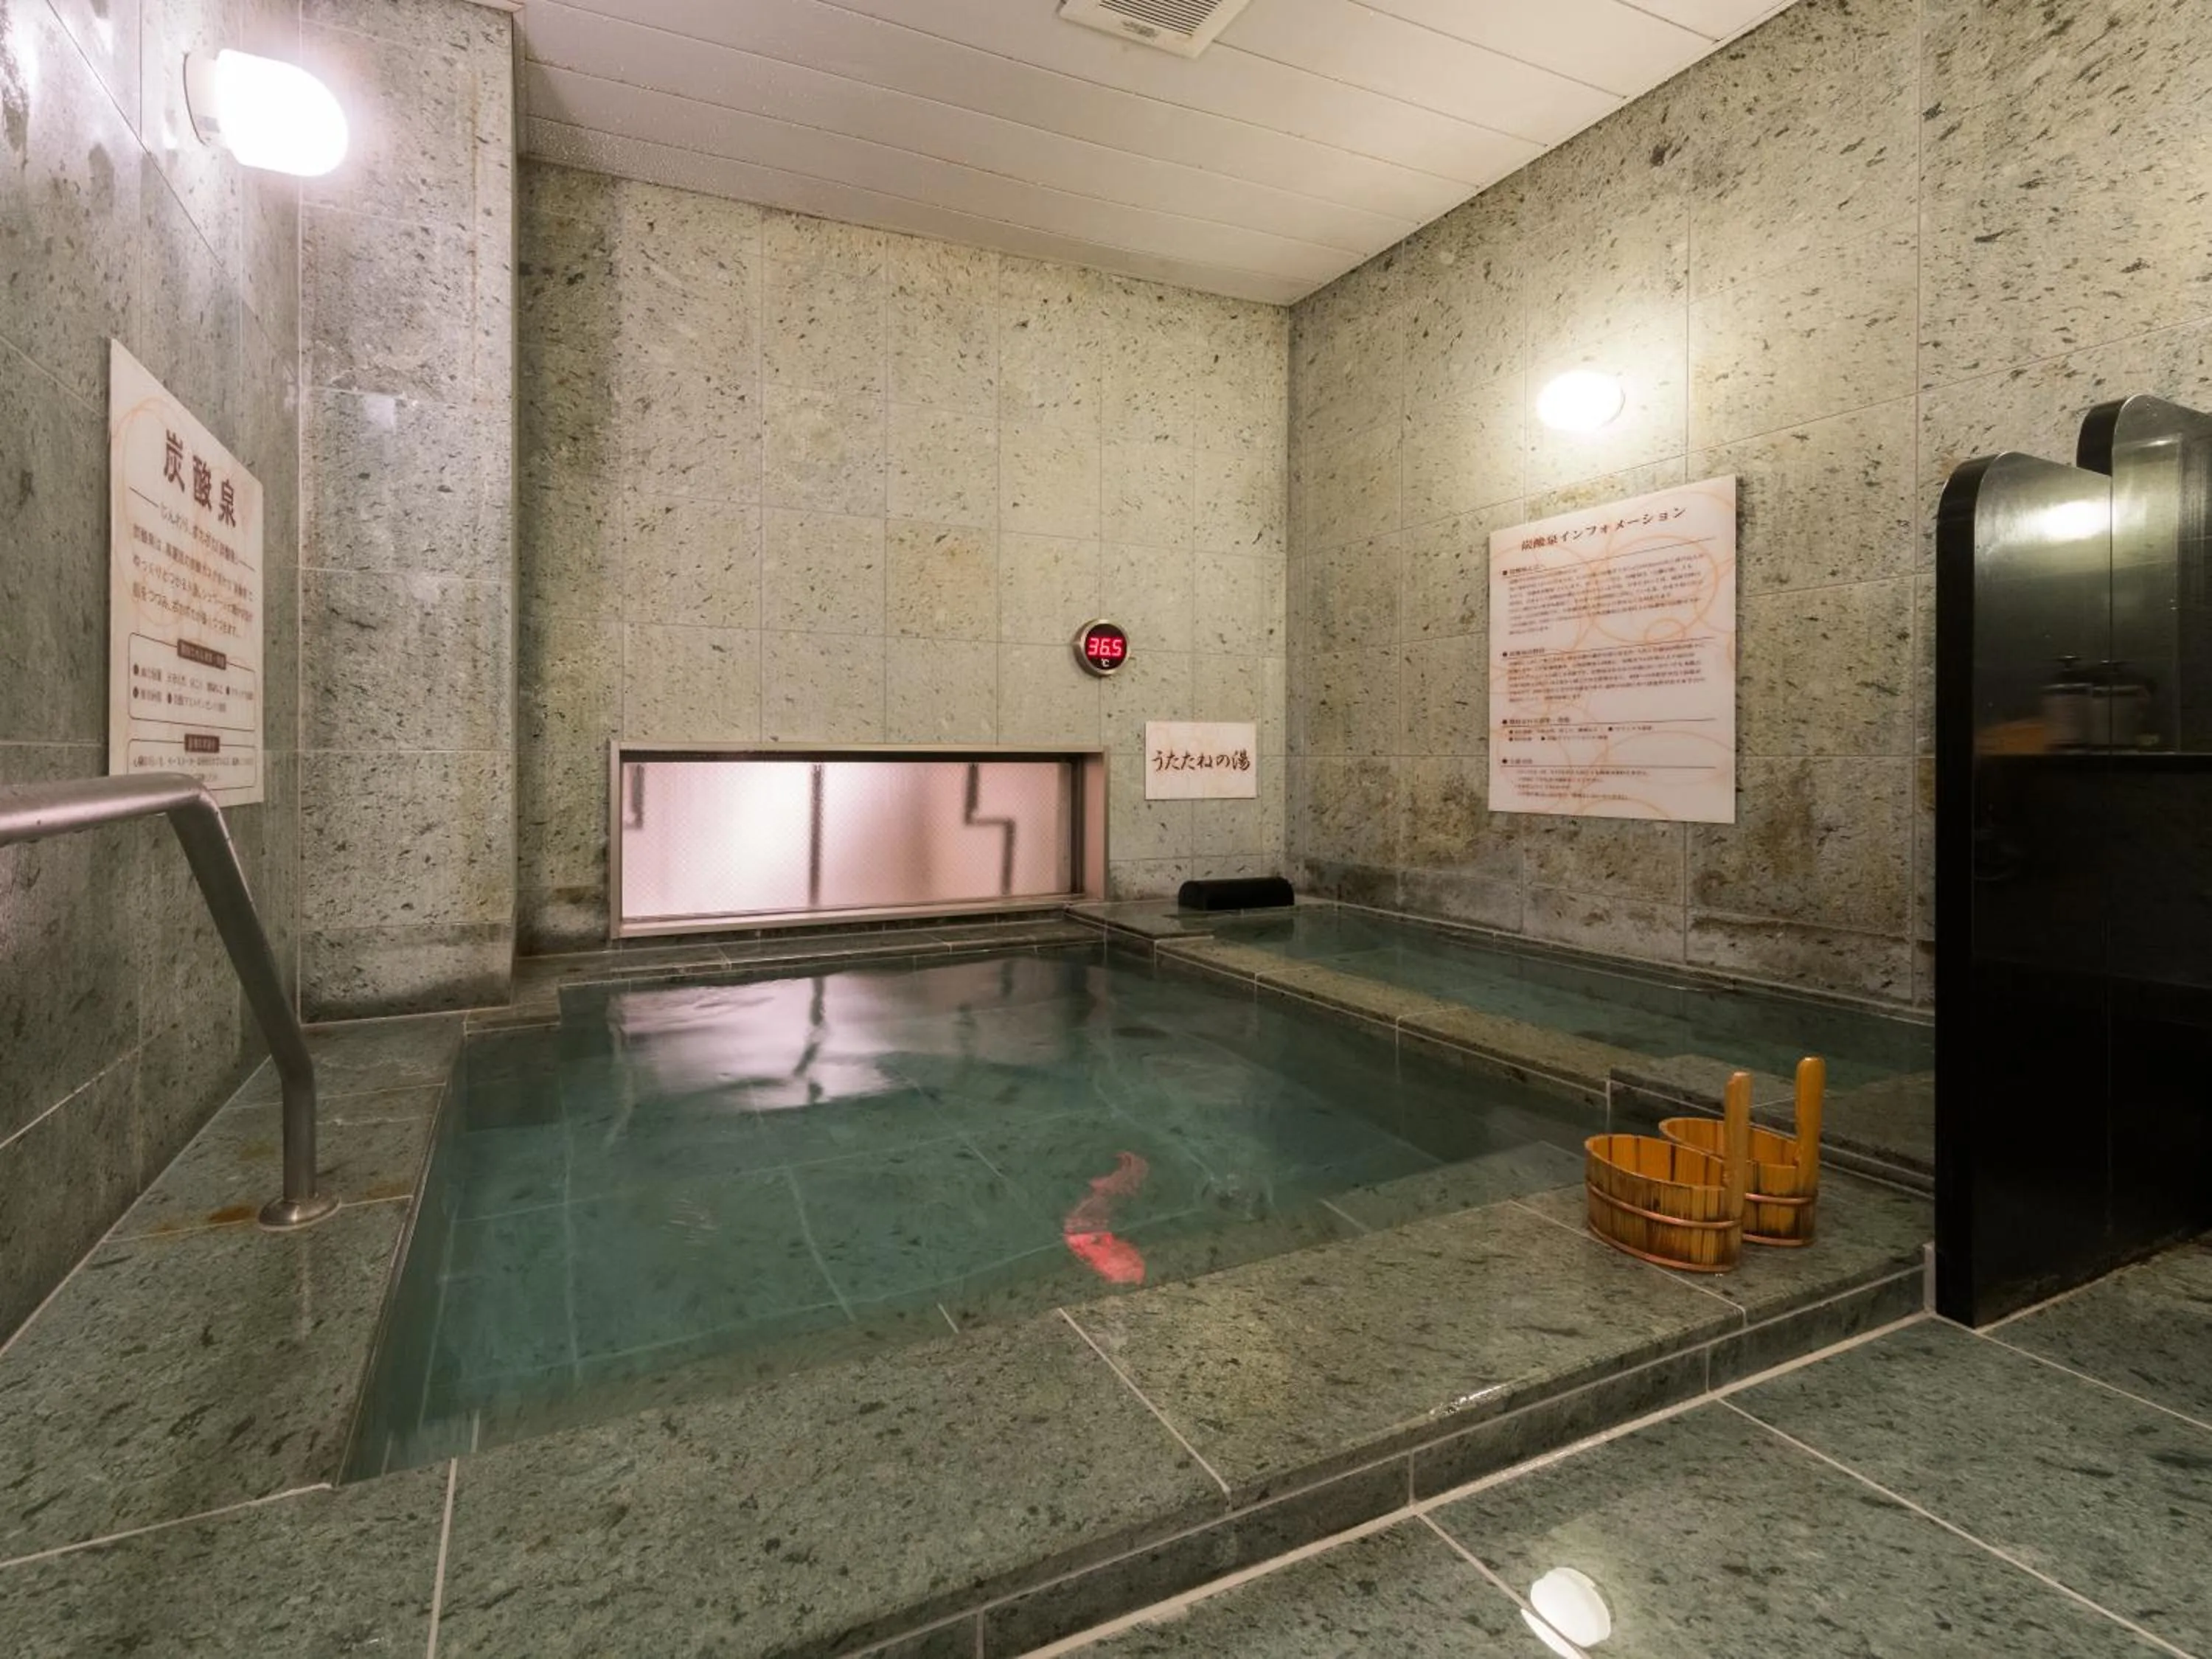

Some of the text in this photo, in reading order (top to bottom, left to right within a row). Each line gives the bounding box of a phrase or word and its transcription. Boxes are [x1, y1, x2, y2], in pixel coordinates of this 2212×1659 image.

[164, 428, 236, 528] 炭酸泉
[1151, 748, 1251, 772] うたたねの湯
